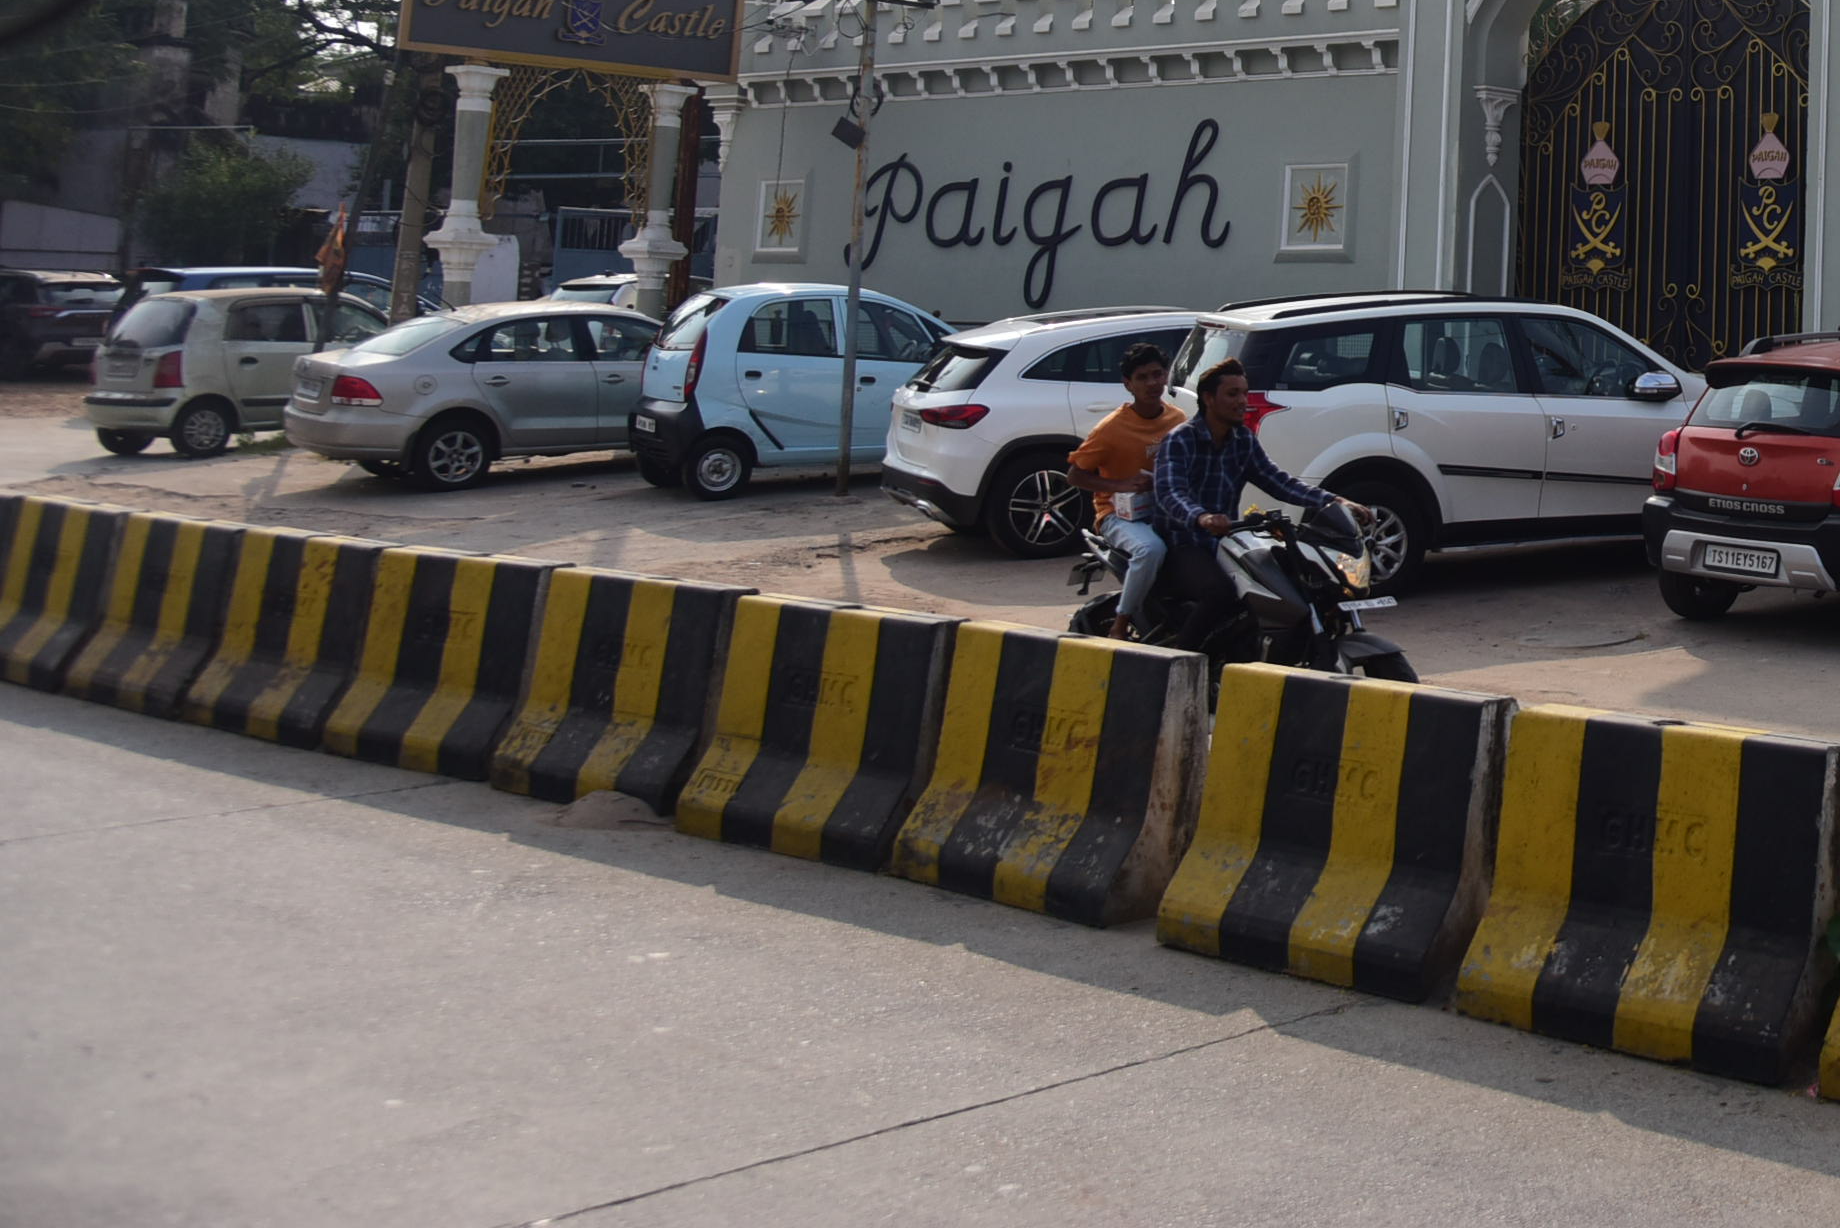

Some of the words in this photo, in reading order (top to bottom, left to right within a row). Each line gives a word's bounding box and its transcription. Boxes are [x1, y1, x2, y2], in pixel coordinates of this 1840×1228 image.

[1751, 148, 1788, 165] PAIGAH
[843, 118, 1231, 310] Paigah
[1596, 273, 1630, 289] CASTLE
[1767, 272, 1803, 286] CASTLE
[1708, 497, 1741, 510] ETIOS
[1742, 501, 1786, 514] CROSS
[1711, 548, 1775, 571] TS11EY5167
